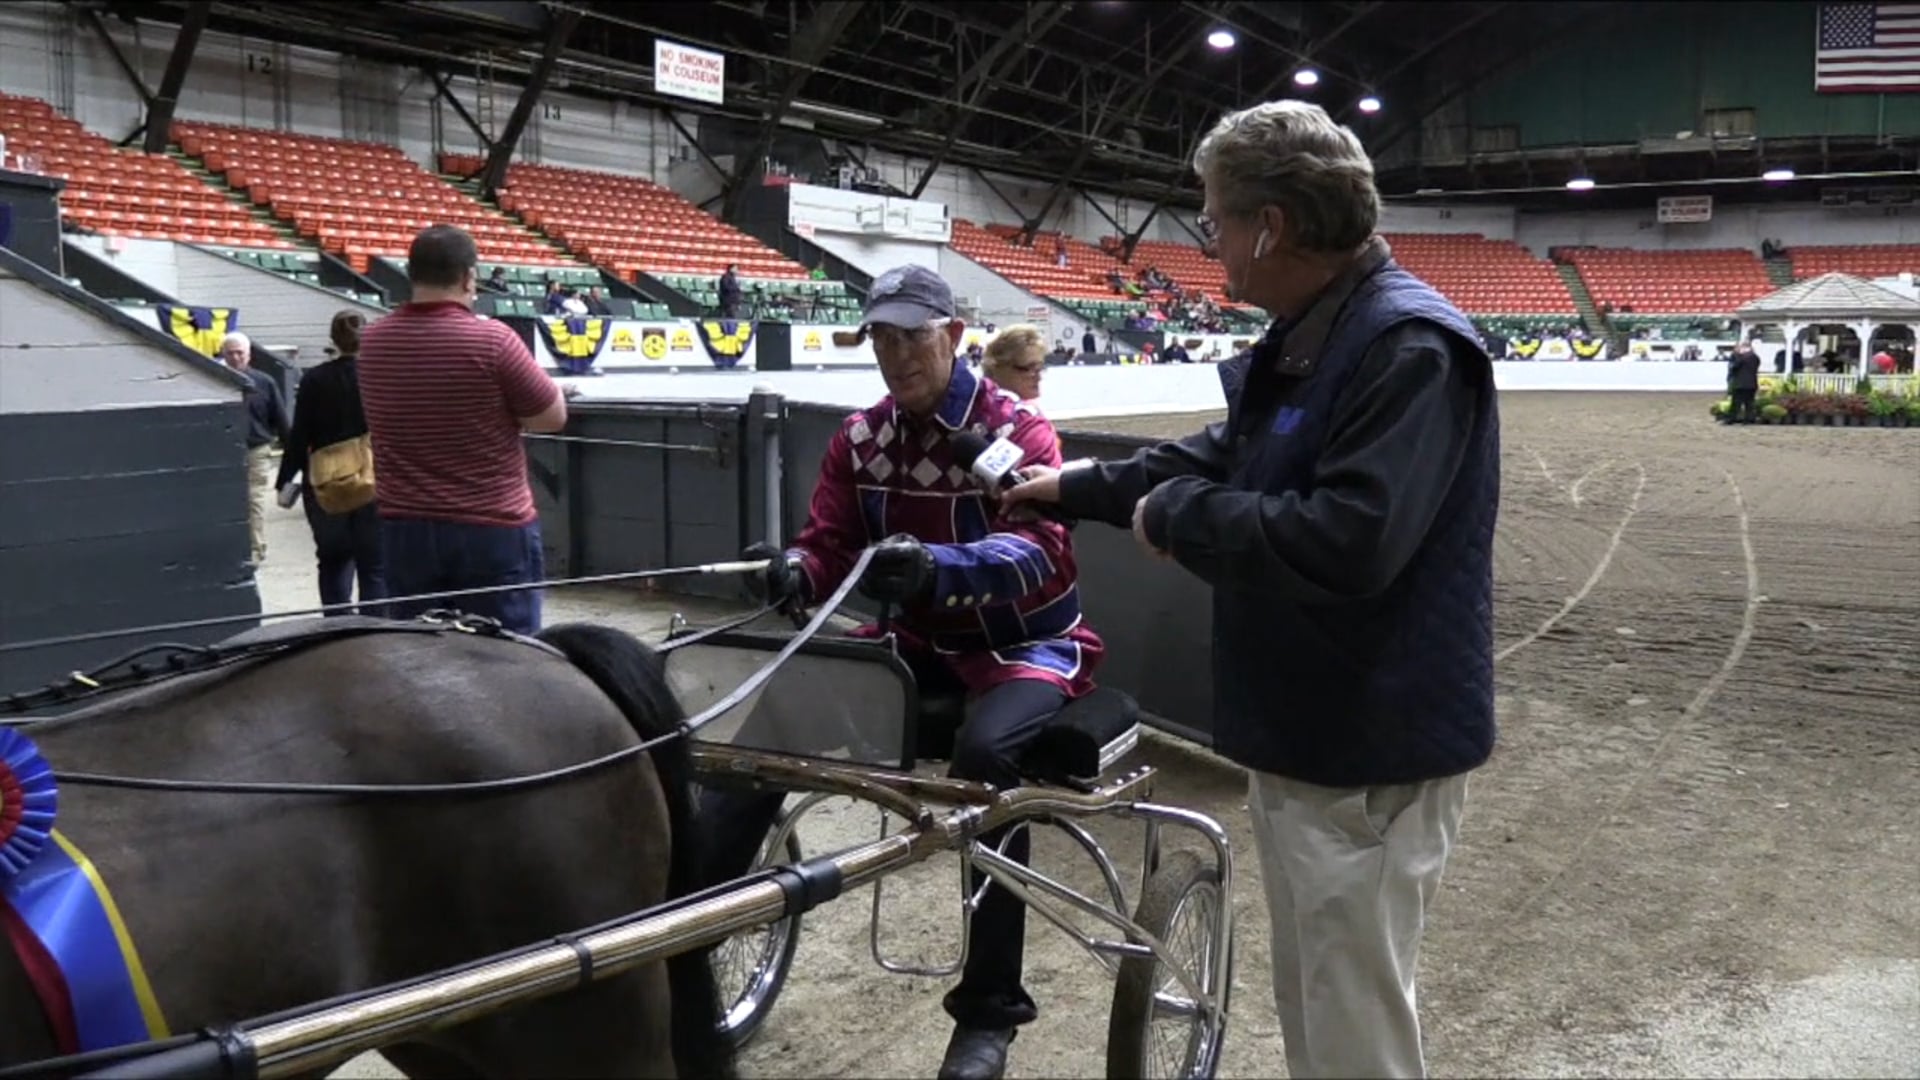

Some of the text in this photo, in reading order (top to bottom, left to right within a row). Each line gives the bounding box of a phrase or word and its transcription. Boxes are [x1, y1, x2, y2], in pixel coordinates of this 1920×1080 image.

[247, 54, 272, 75] 12
[660, 47, 720, 71] NO SMOKING
[660, 62, 720, 84] IN COLISEUM
[543, 104, 561, 120] 13
